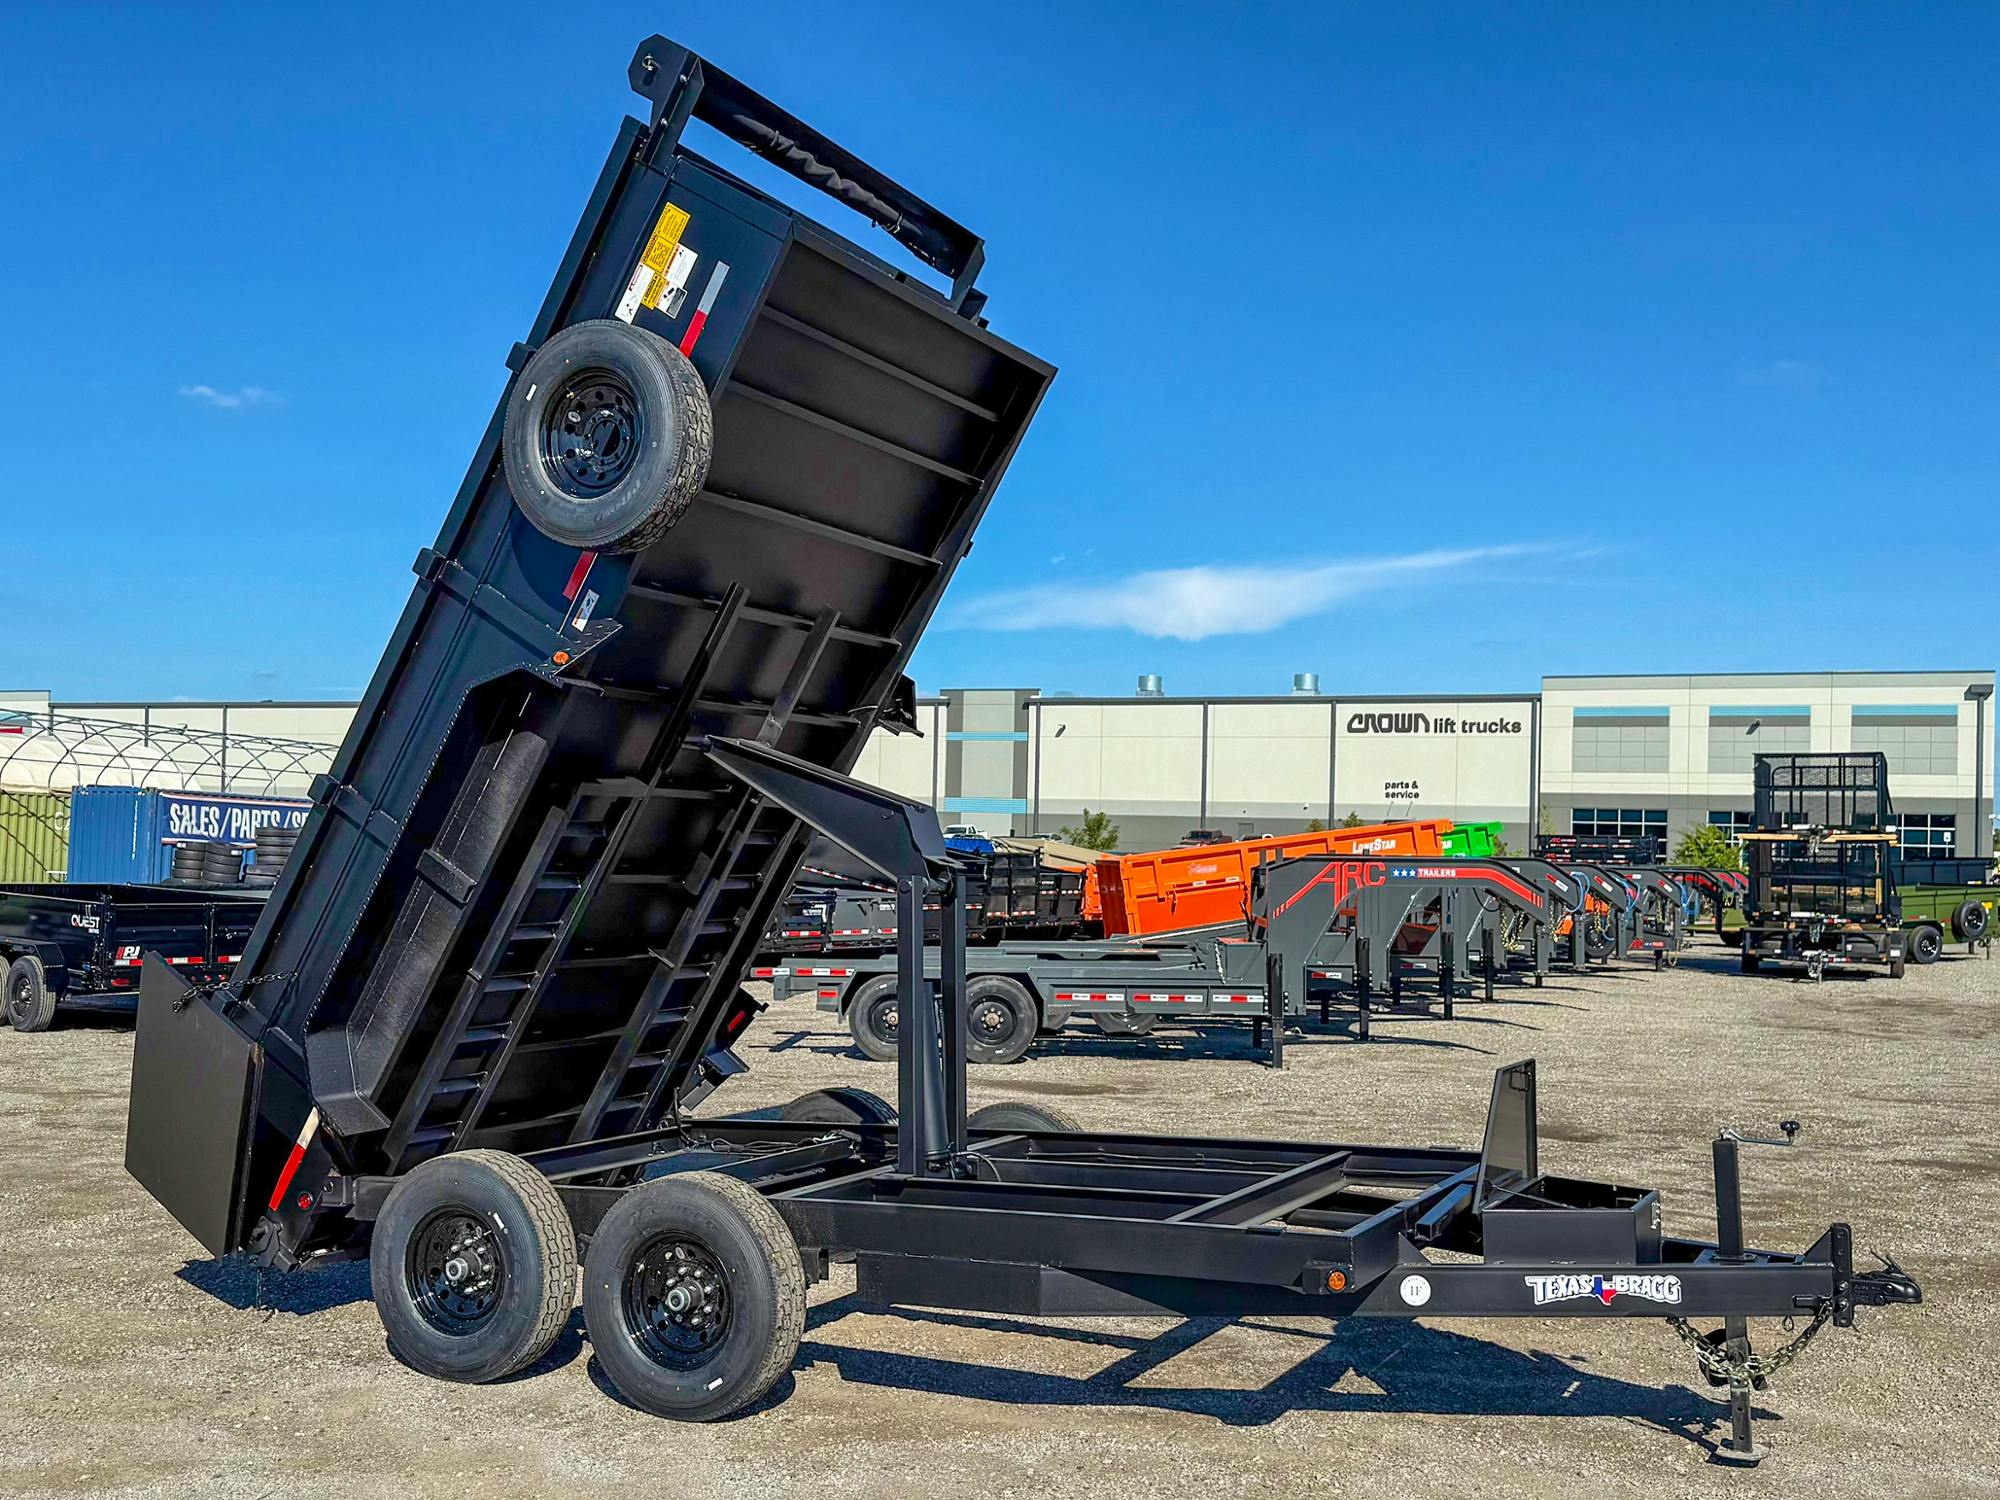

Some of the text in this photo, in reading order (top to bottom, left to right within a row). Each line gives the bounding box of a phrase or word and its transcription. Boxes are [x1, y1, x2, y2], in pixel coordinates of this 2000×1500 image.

[1347, 713, 1521, 733] CROWN lift trucks
[1384, 780, 1419, 790] parts &
[1384, 790, 1420, 799] service
[1284, 861, 1457, 908] ARC TRAILERS
[71, 914, 101, 928] QUEST
[124, 945, 141, 957] PJ
[1525, 1275, 1682, 1304] TEXAS BRAGG
